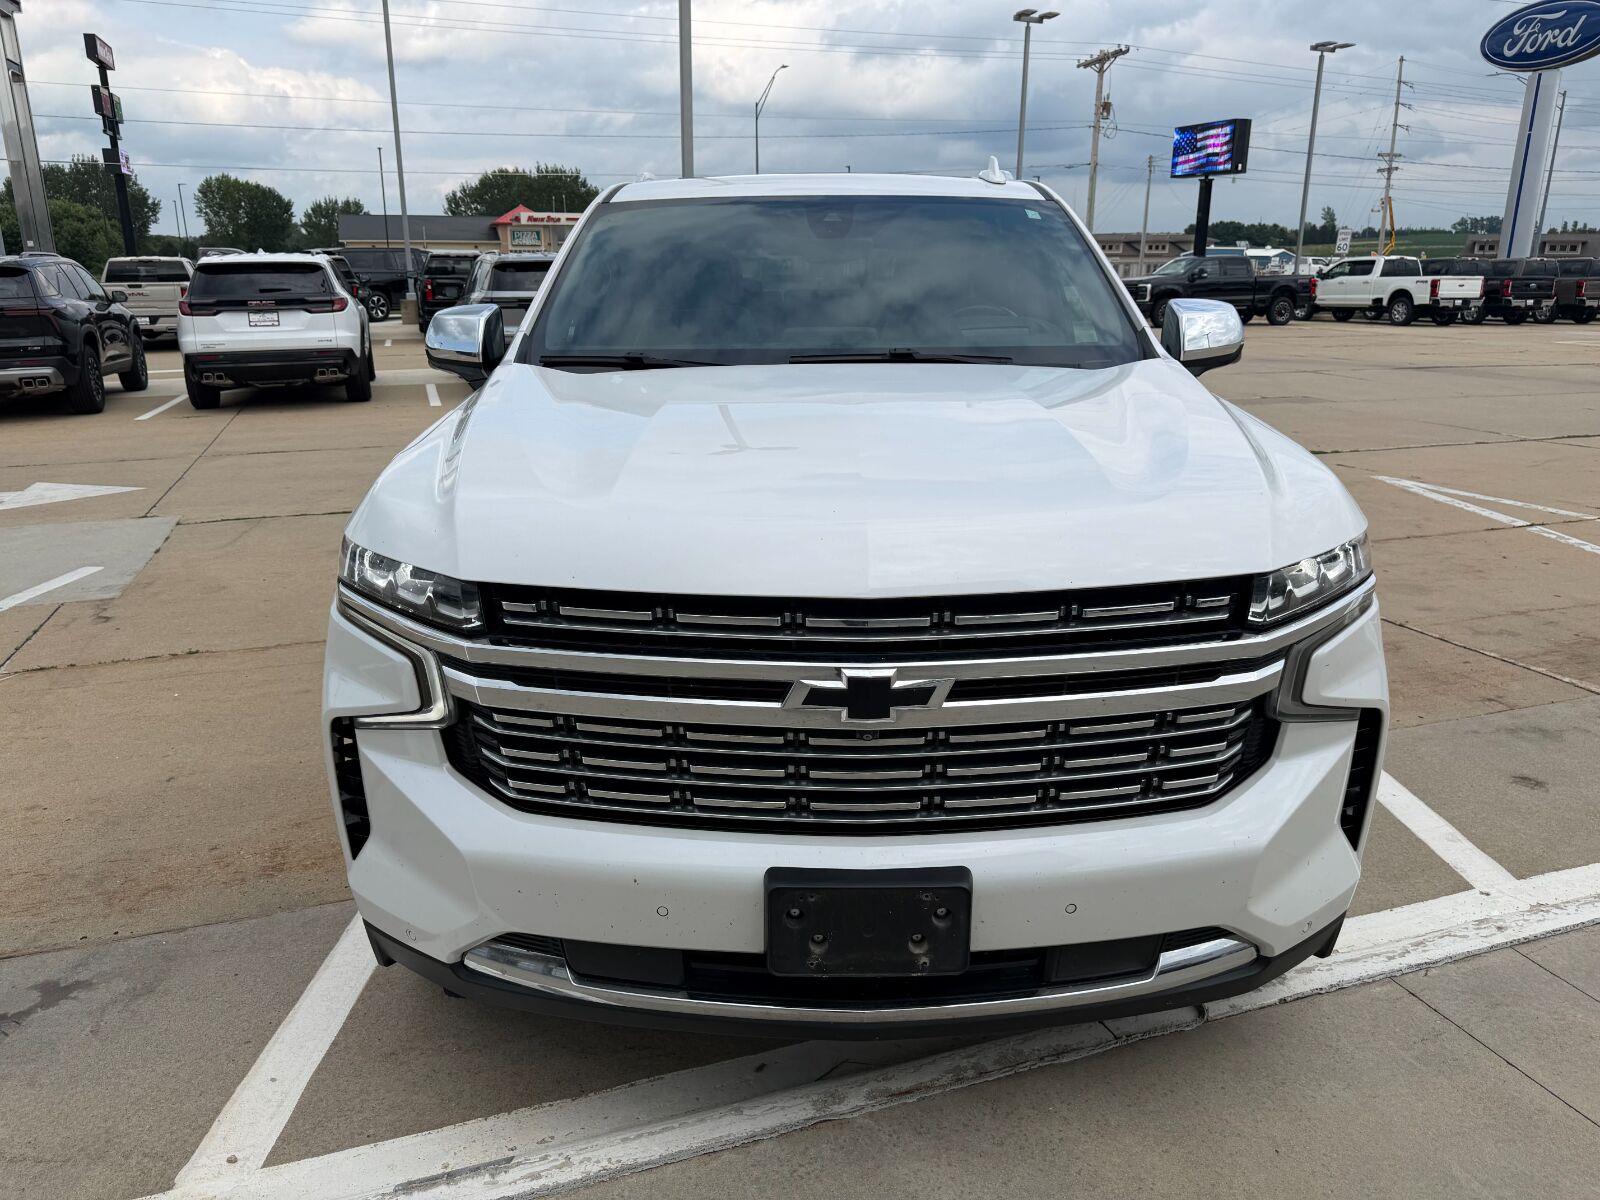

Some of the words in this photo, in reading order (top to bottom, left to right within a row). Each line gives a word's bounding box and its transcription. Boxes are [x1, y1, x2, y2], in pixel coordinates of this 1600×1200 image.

[1503, 9, 1587, 57] Ford
[514, 231, 538, 240] PIZZA
[1336, 243, 1348, 251] 60
